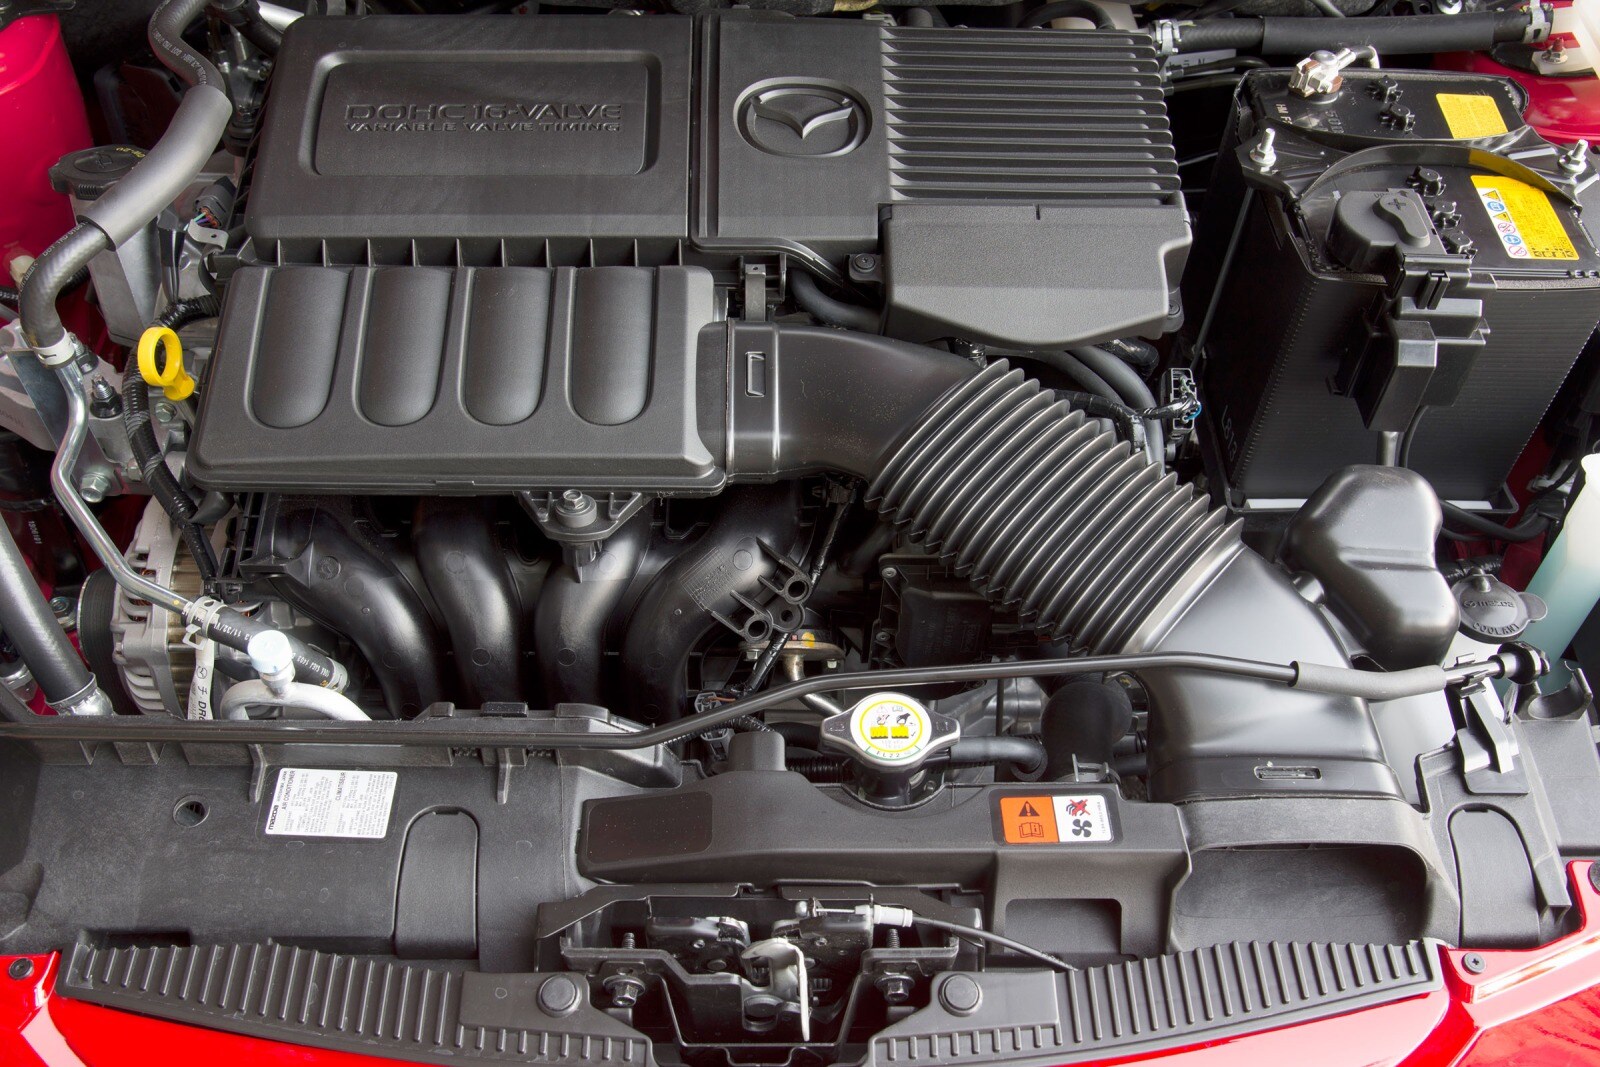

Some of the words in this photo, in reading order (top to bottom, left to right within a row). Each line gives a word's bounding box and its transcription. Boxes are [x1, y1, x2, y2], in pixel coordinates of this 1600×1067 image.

[344, 103, 467, 121] DOHC
[473, 103, 622, 121] 16-VALVE
[344, 122, 457, 133] VARIABLE
[462, 122, 534, 133] VALVE
[539, 122, 621, 133] TIMING
[1472, 622, 1520, 635] COOLANT
[284, 771, 296, 801] CONDITIONER
[335, 772, 346, 800] CLIMATISEUR
[268, 804, 279, 830] mazda
